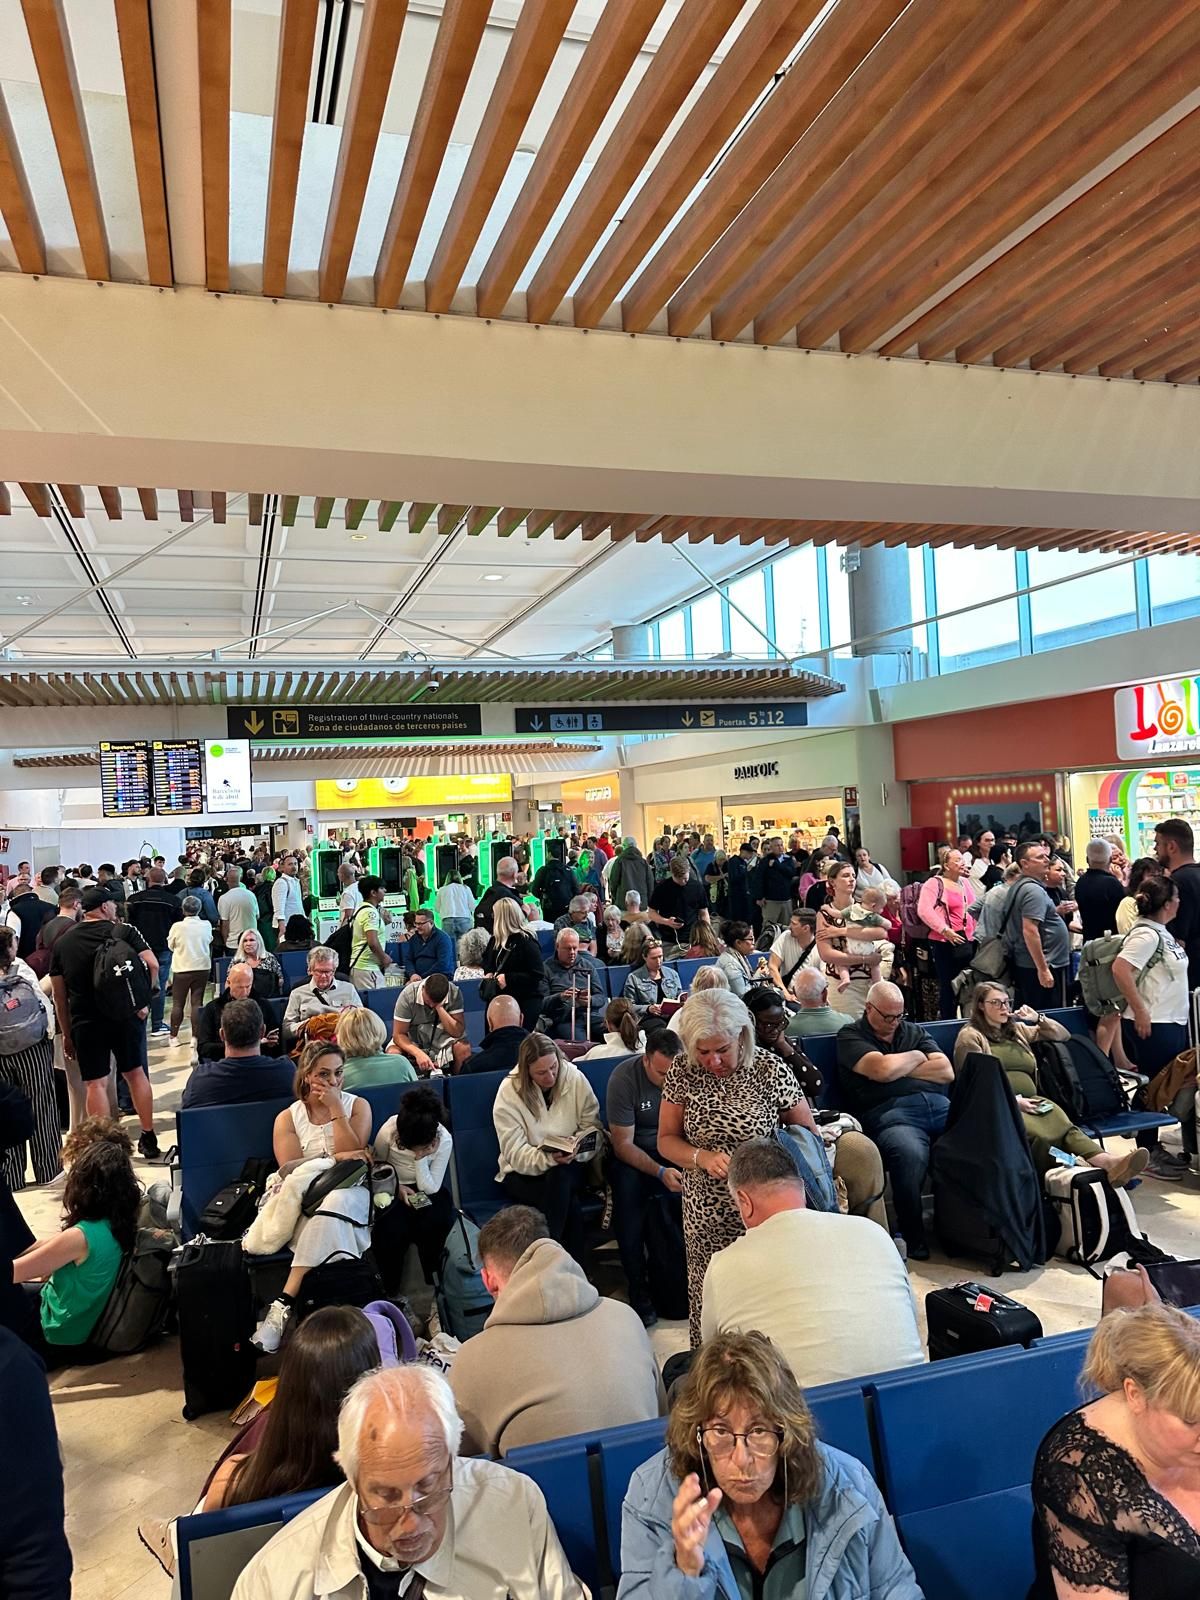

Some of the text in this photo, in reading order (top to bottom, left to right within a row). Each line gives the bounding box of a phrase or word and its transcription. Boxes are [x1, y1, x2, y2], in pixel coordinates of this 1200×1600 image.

[308, 712, 459, 723] Registration of third-country nationals
[749, 712, 758, 725] 5
[767, 711, 784, 724] 12
[308, 723, 330, 732] Zona
[332, 723, 343, 731] de
[344, 723, 393, 731] ciudadanos
[395, 722, 405, 730] de
[407, 722, 440, 730] terceros
[240, 827, 256, 835] 5.6
[330, 925, 338, 933] 07
